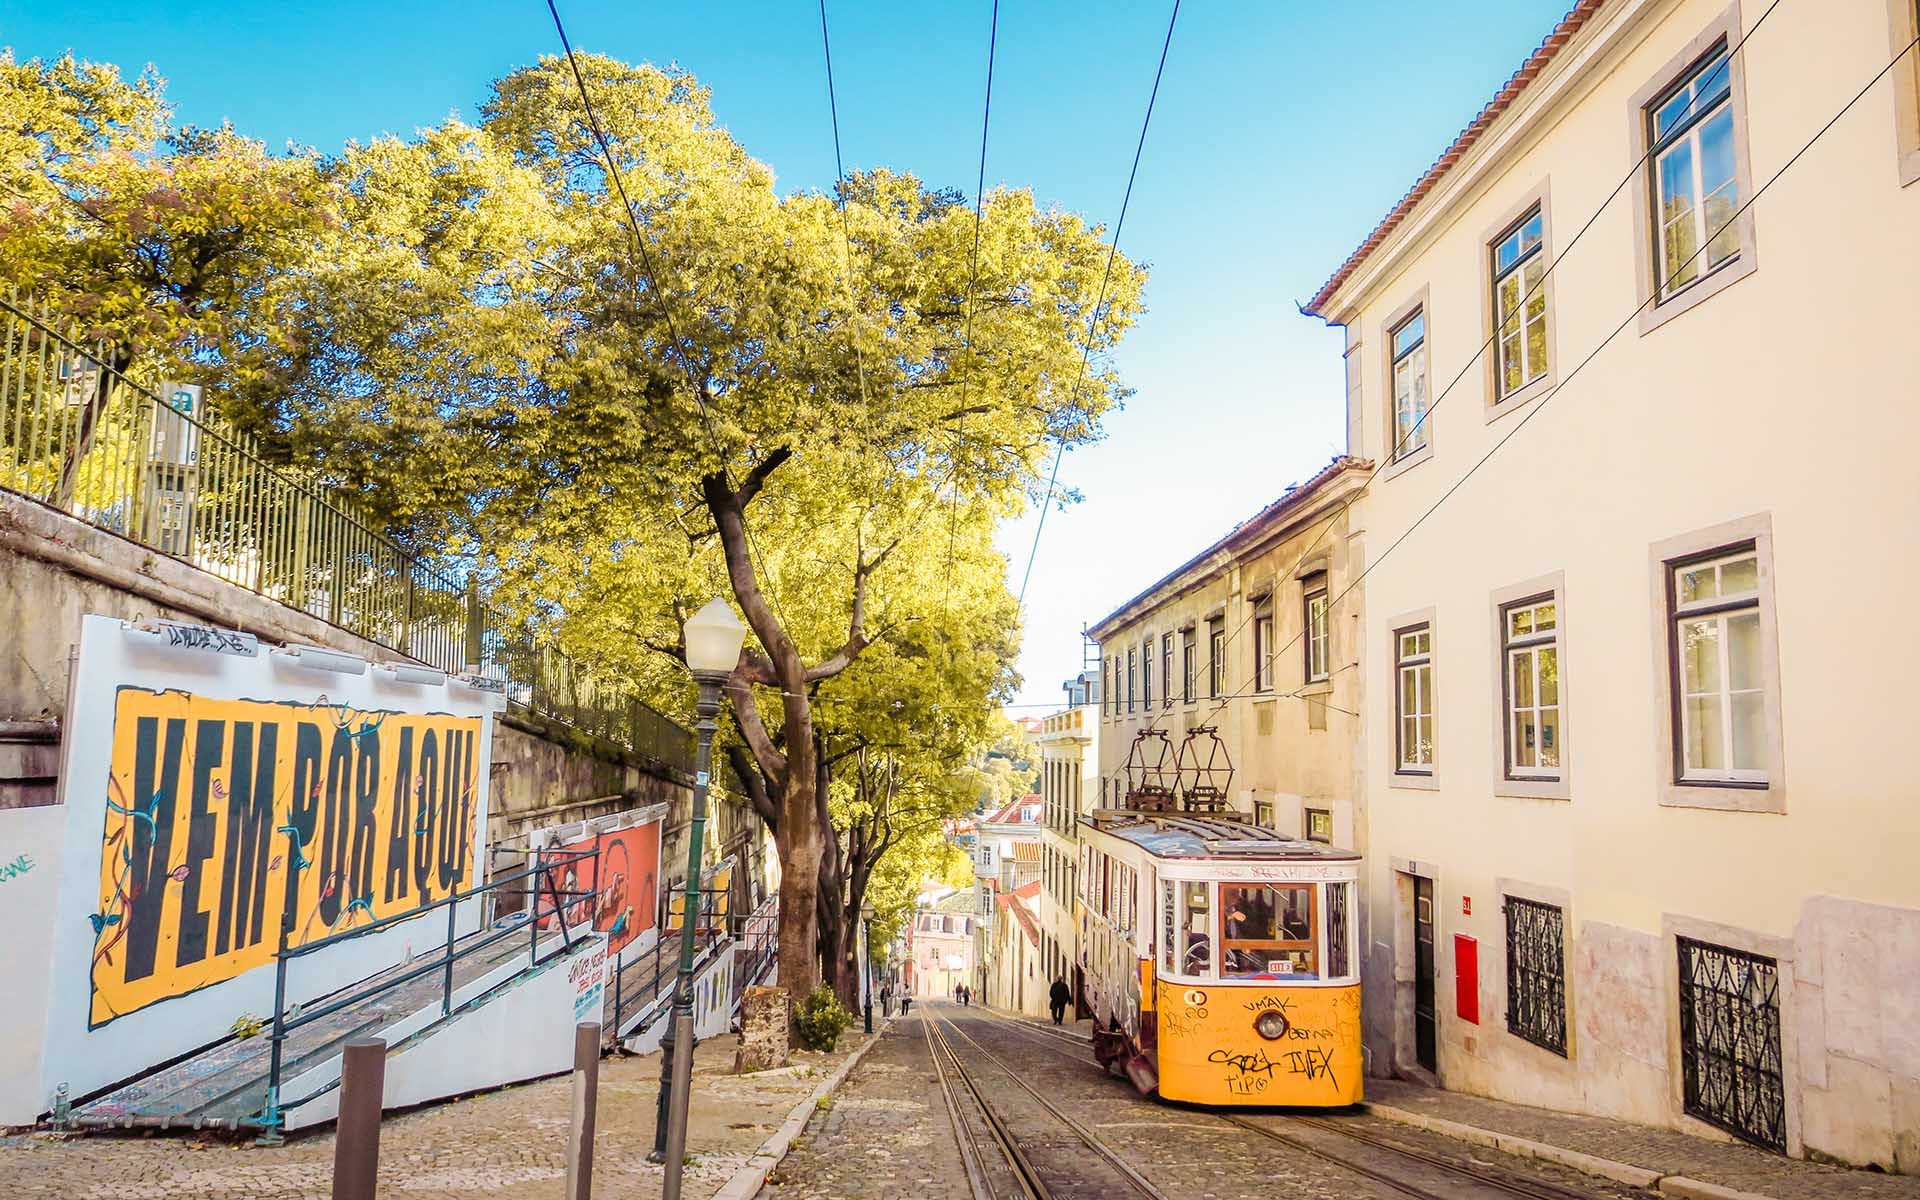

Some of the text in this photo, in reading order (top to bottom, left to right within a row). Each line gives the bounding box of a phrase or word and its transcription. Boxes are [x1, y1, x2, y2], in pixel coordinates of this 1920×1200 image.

[124, 716, 474, 984] VEM POR AQUI
